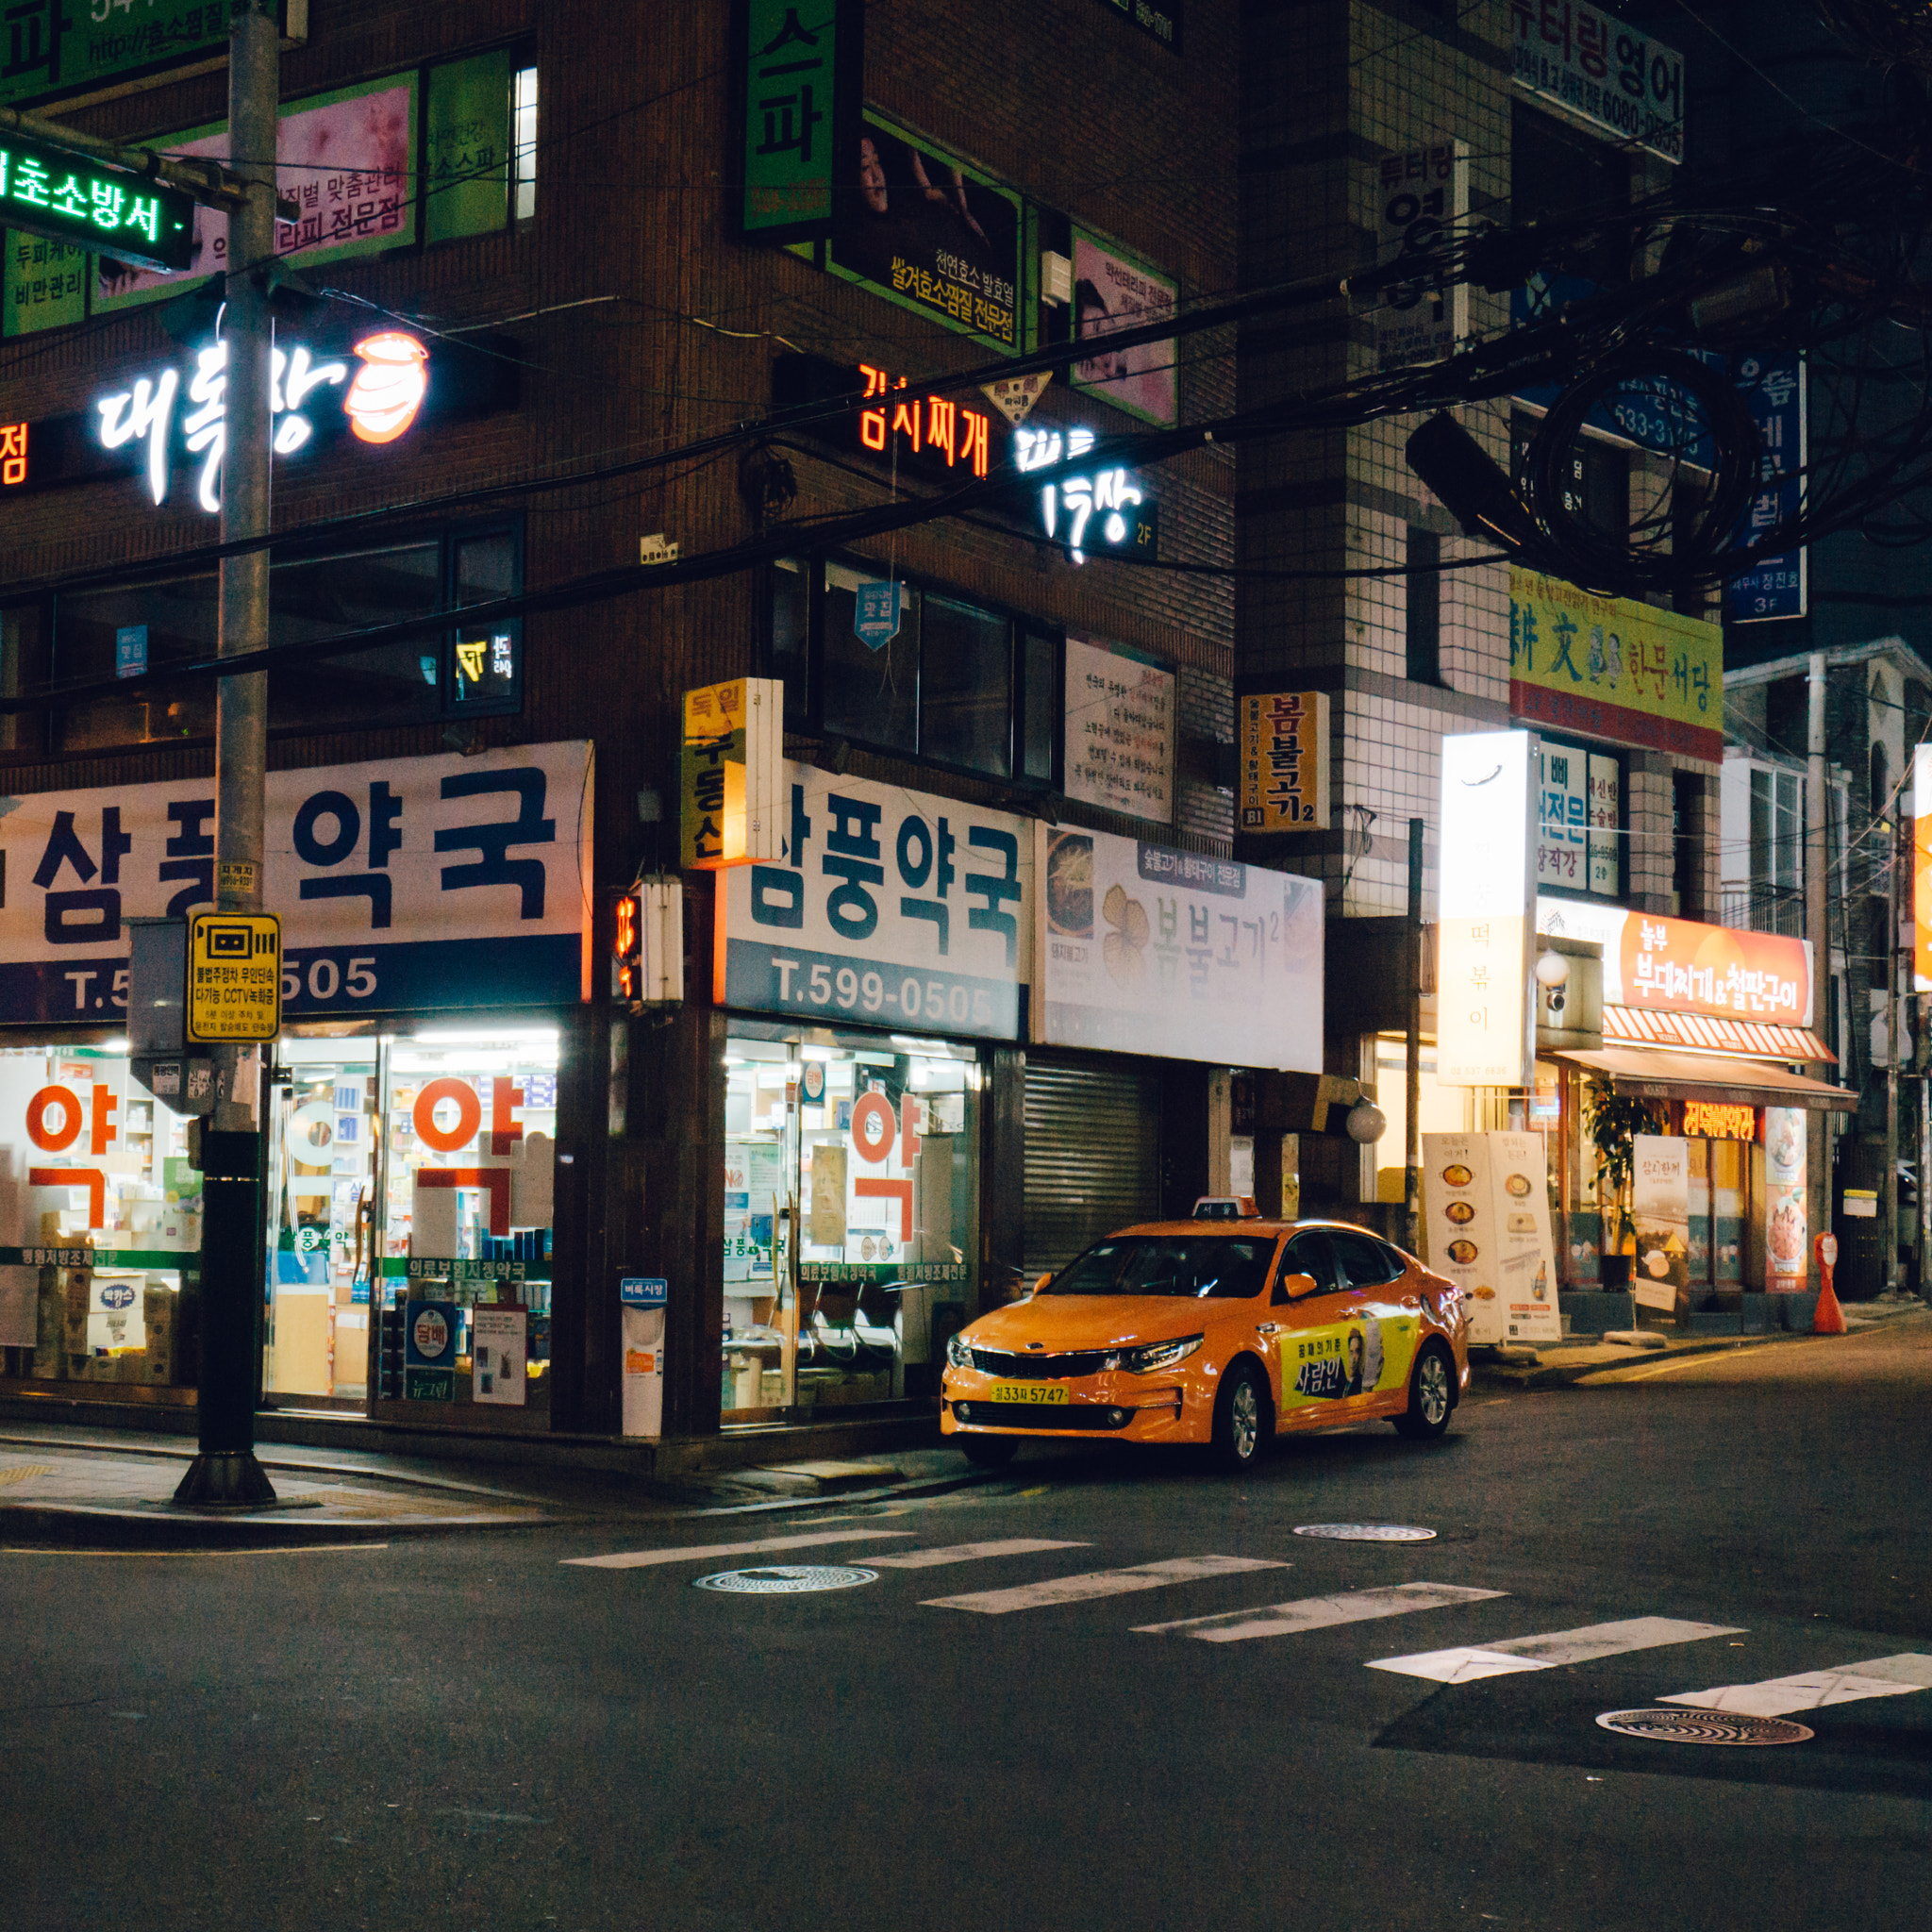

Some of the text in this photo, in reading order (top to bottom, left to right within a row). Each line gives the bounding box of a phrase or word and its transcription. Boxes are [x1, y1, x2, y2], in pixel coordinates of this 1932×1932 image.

[756, 8, 824, 161] 스파
[1616, 34, 1681, 120] 영어
[332, 193, 399, 240] 전문점
[15, 269, 82, 306] 비만관리
[974, 297, 1013, 342] 전문점
[1138, 522, 1153, 546] 2F
[1754, 597, 1777, 613] 3F
[1265, 695, 1314, 823] 봄불고기 2
[1640, 919, 1669, 953] 놀부
[195, 987, 221, 1005] 다기능
[196, 966, 275, 985] 불법주정차 무인단속
[771, 957, 991, 1025] T.599-0505
[1468, 922, 1491, 1032] 떡볶이
[26, 1084, 117, 1228] 약
[412, 1076, 525, 1238] 약
[851, 1090, 922, 1243] 약
[409, 1259, 526, 1281] 의료보험지정약국
[624, 1283, 664, 1296] 벼룩시장
[416, 1323, 445, 1345] 담배
[1030, 1388, 1064, 1403] 5747
[1294, 1354, 1342, 1396] 사람인
